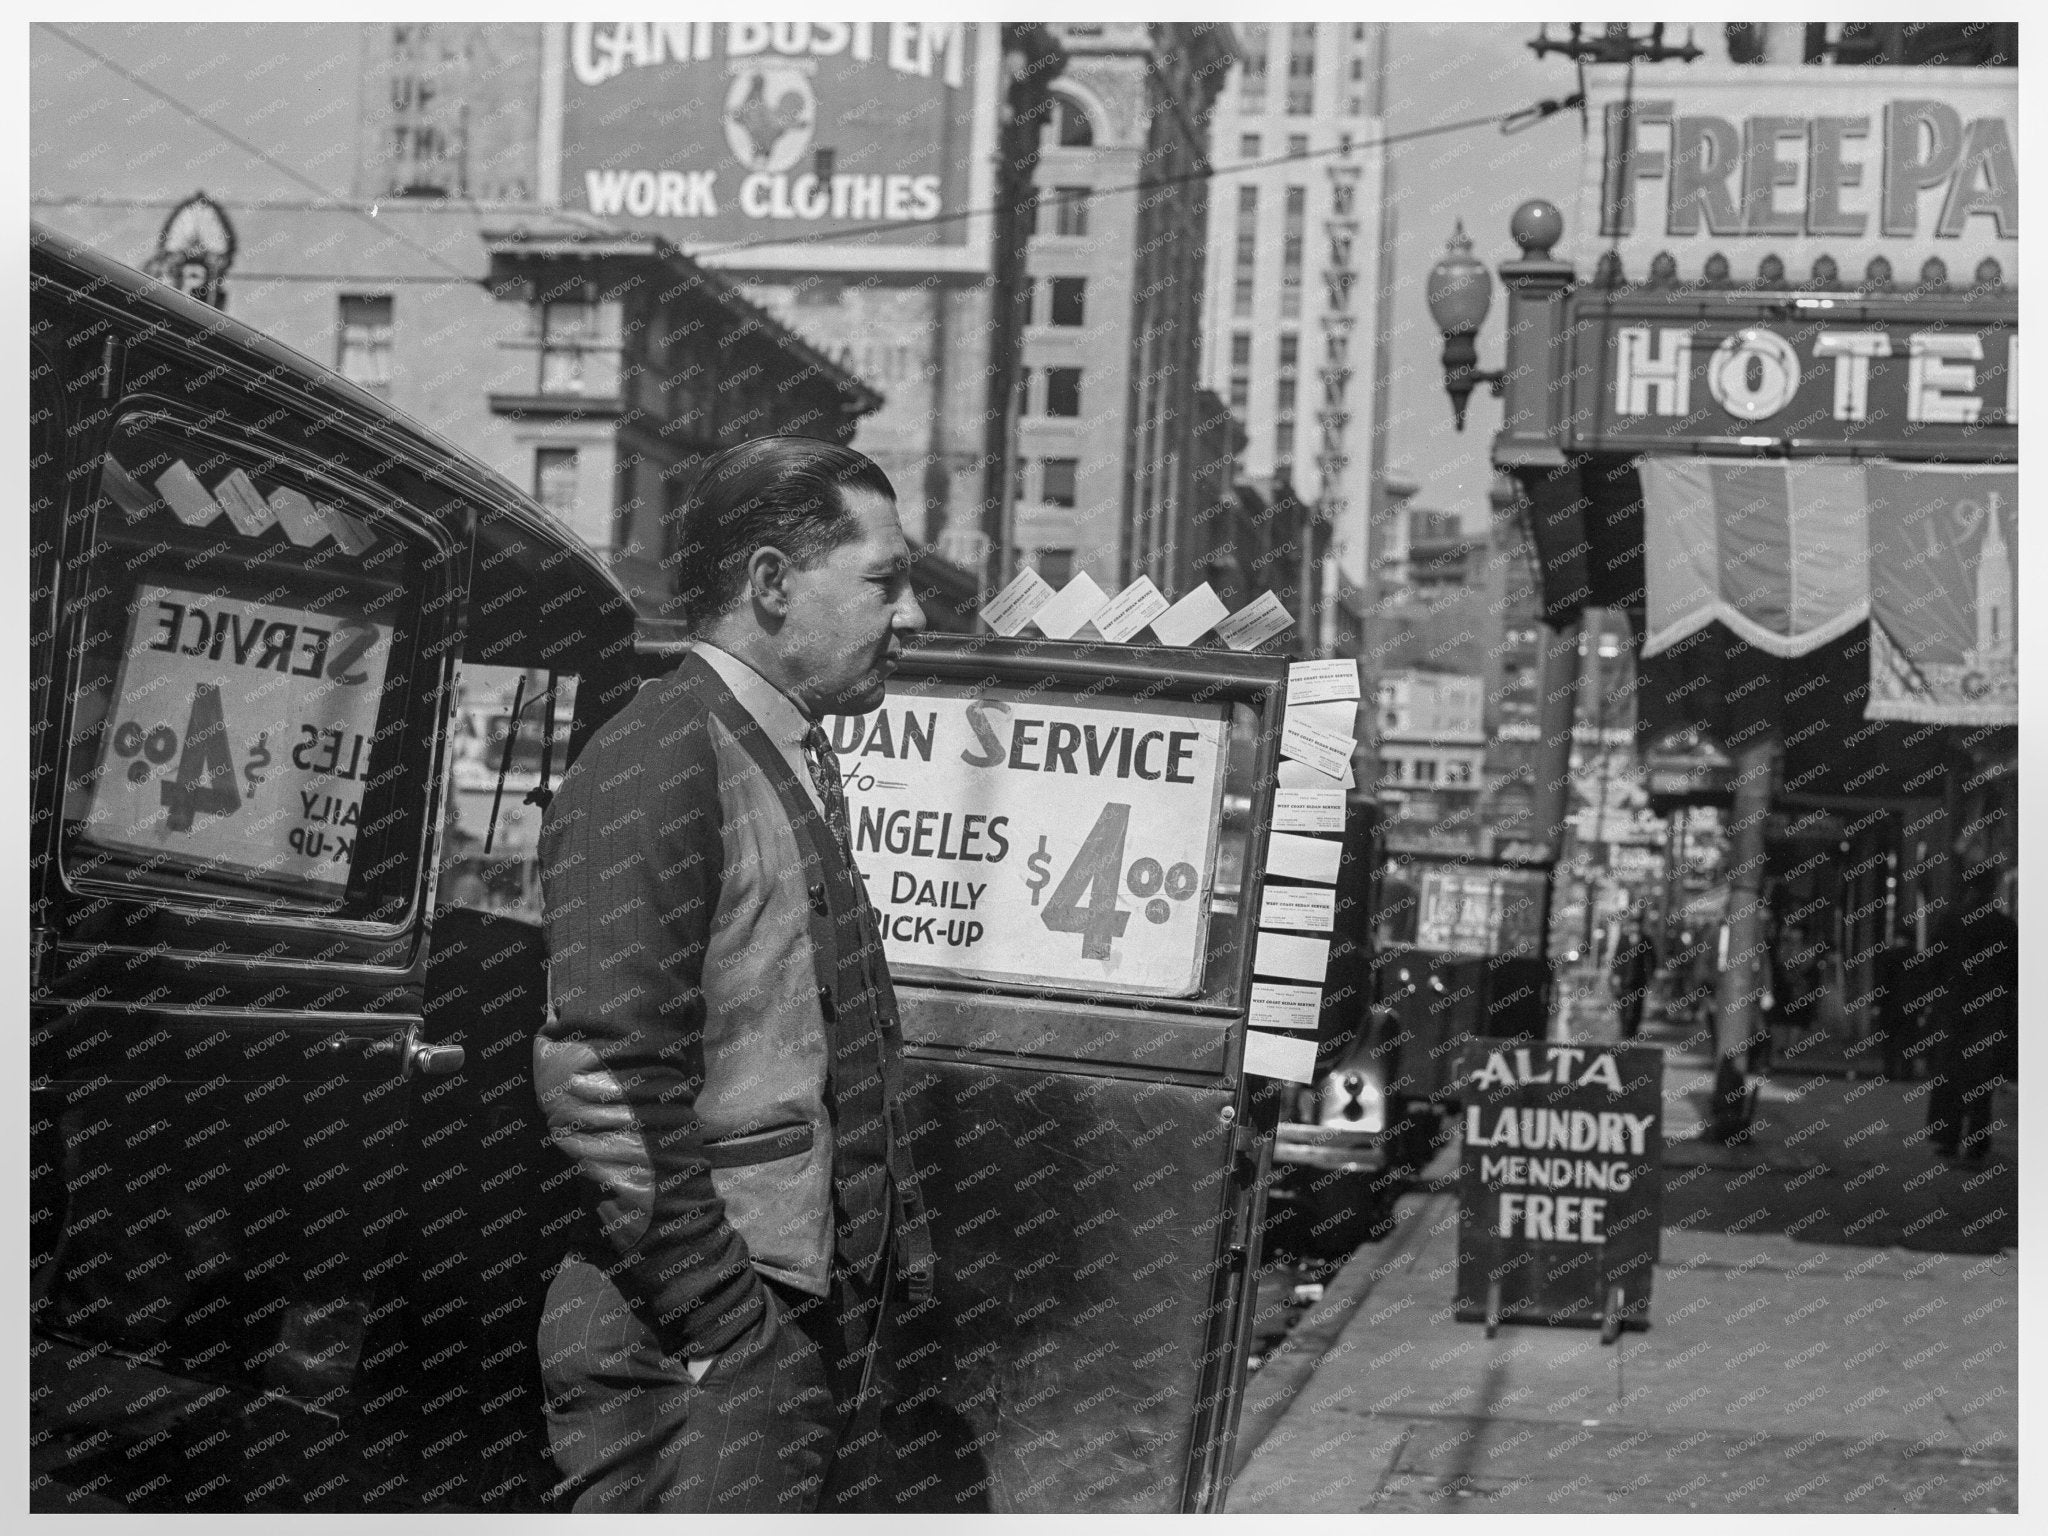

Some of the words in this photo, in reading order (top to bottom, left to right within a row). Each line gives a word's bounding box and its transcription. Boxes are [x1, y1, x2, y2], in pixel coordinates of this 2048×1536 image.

[1599, 98, 1871, 238] FREE
[584, 170, 719, 218] WORK
[739, 171, 943, 221] CLOTHES
[960, 699, 1200, 784] SERVICE
[891, 871, 987, 911] DAILY
[1470, 1048, 1623, 1093] ALTA
[1465, 1105, 1655, 1155] LAUNDRY
[1480, 1154, 1632, 1192] MENDING
[1498, 1192, 1608, 1244] FREE
